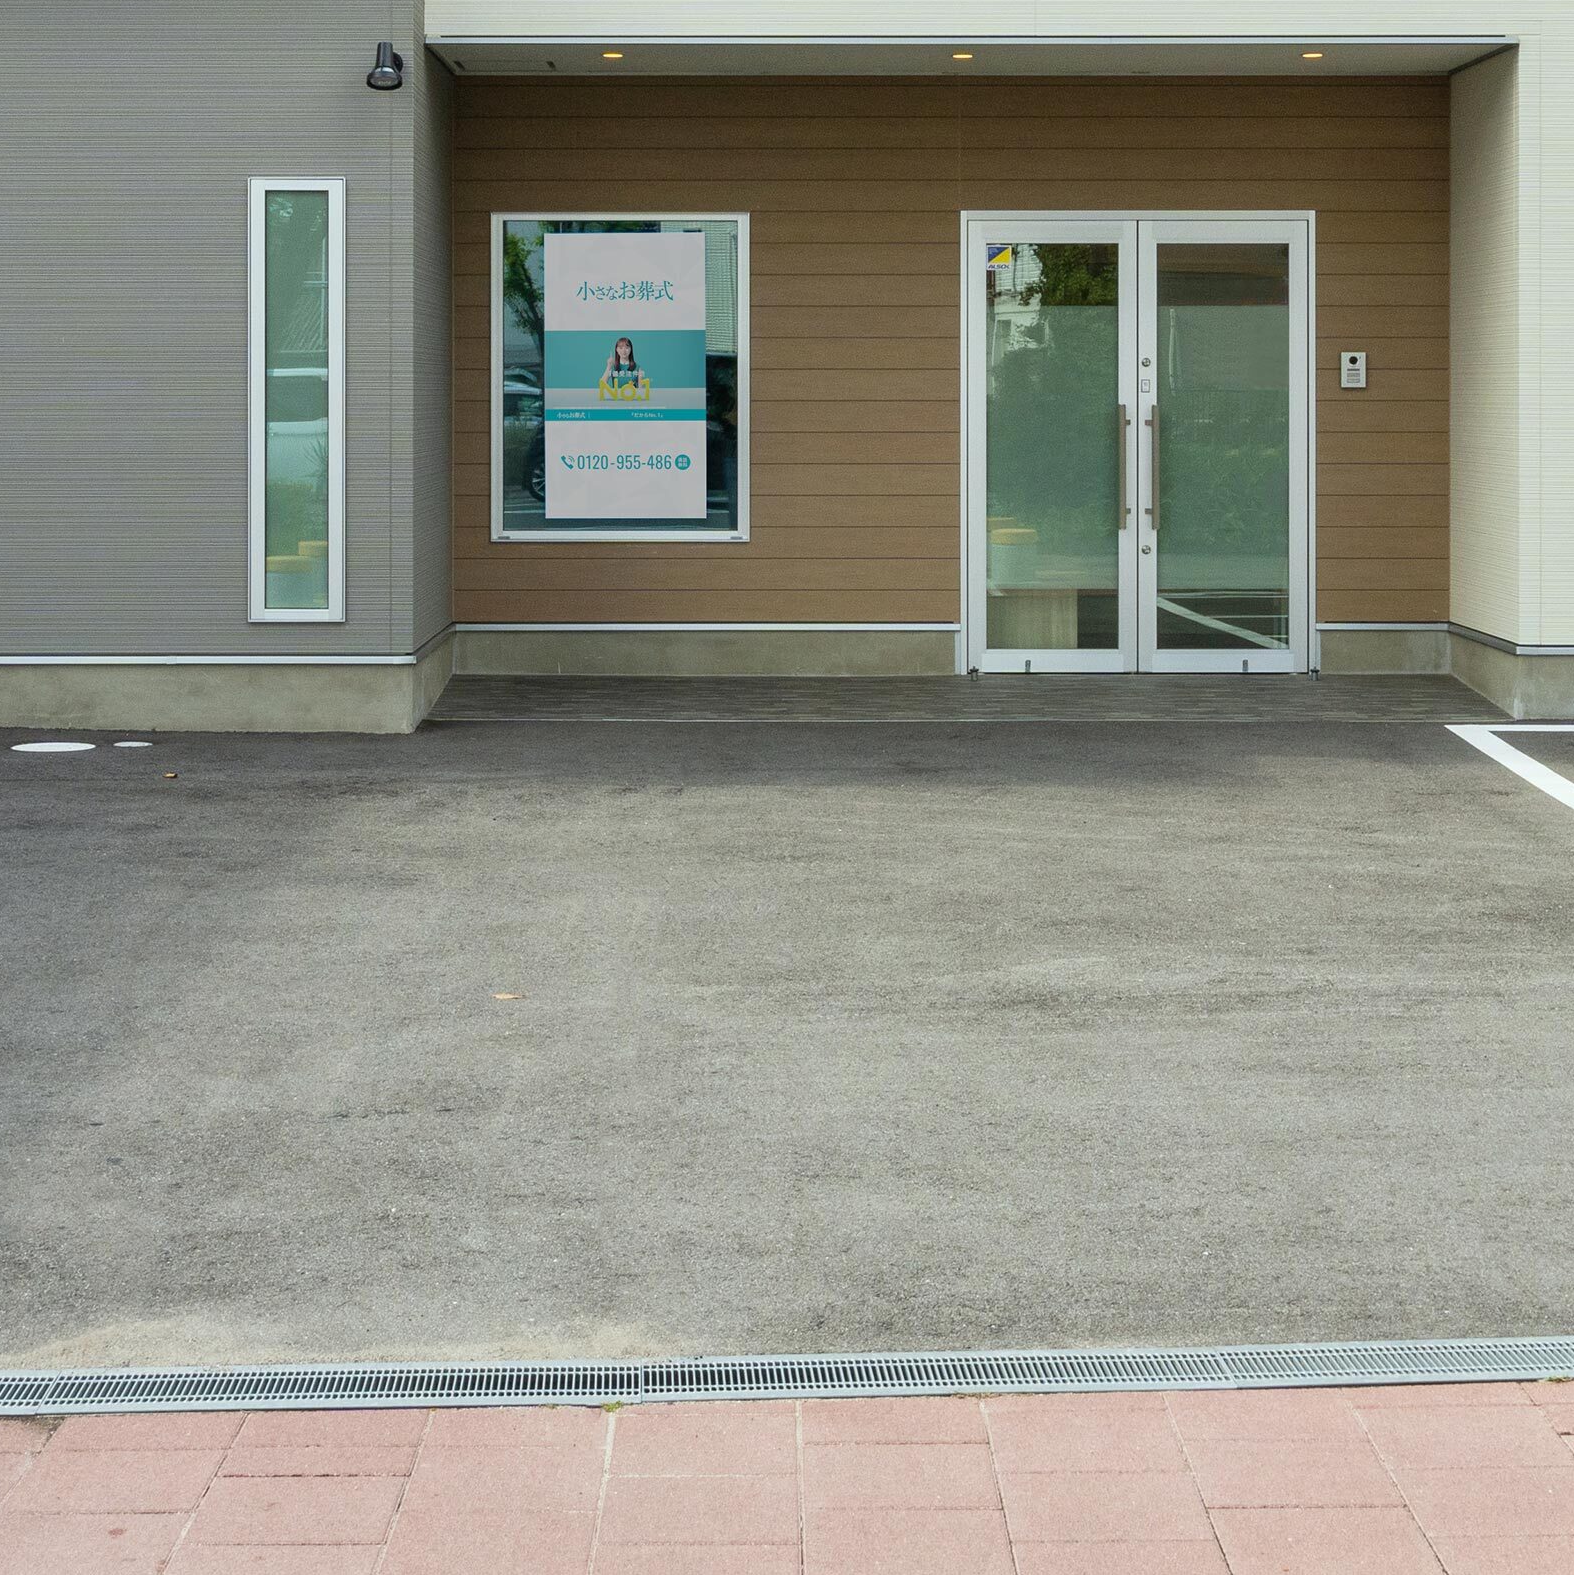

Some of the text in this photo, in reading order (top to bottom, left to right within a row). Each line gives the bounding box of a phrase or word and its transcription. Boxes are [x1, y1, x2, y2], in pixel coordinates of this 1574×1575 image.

[576, 281, 674, 301] 小さなお葬式
[599, 378, 650, 401] No.1
[577, 455, 672, 470] 0120-955-486
